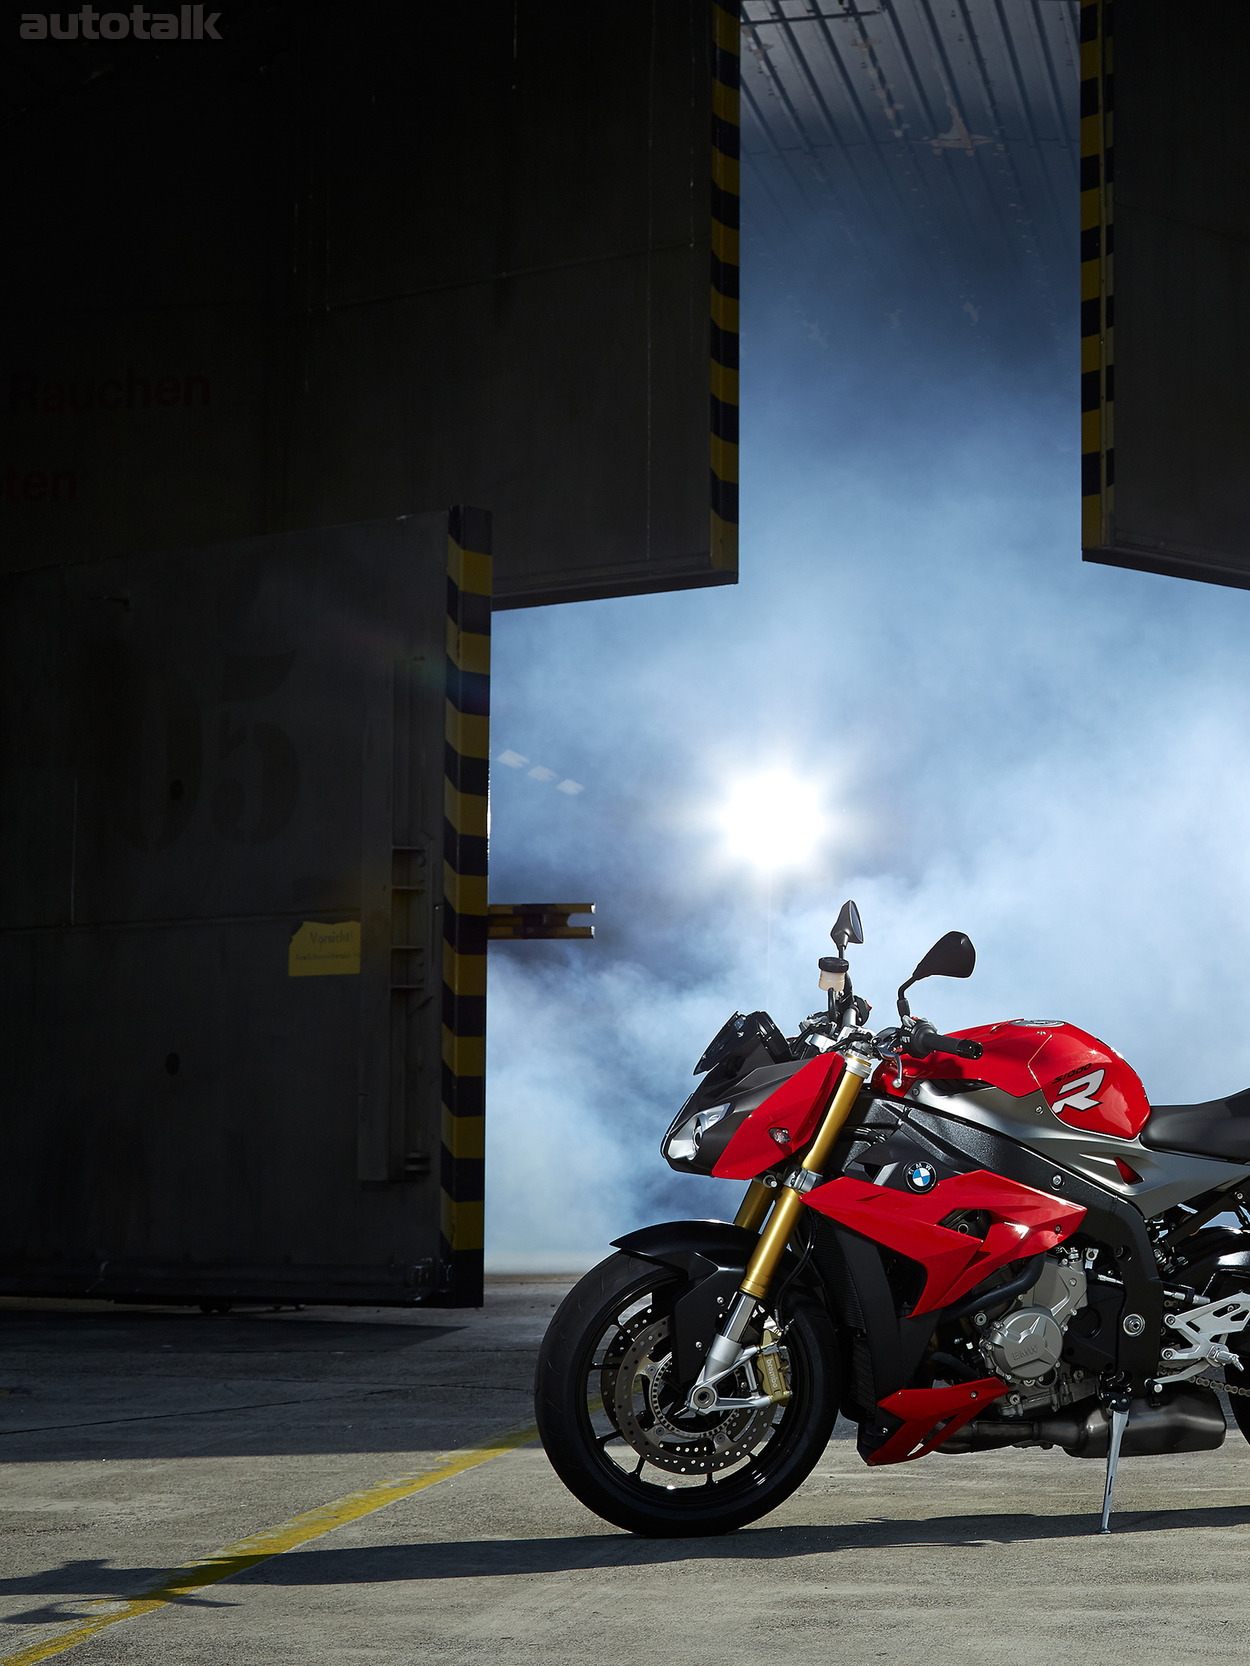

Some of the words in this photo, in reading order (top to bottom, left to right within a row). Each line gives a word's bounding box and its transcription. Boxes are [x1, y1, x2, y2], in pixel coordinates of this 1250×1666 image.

[9, 367, 211, 414] Rauchen
[0, 464, 78, 502] ten
[1051, 1062, 1092, 1085] S1000
[1051, 1067, 1106, 1115] R
[907, 1161, 933, 1175] BMW
[766, 1357, 779, 1389] brembo
